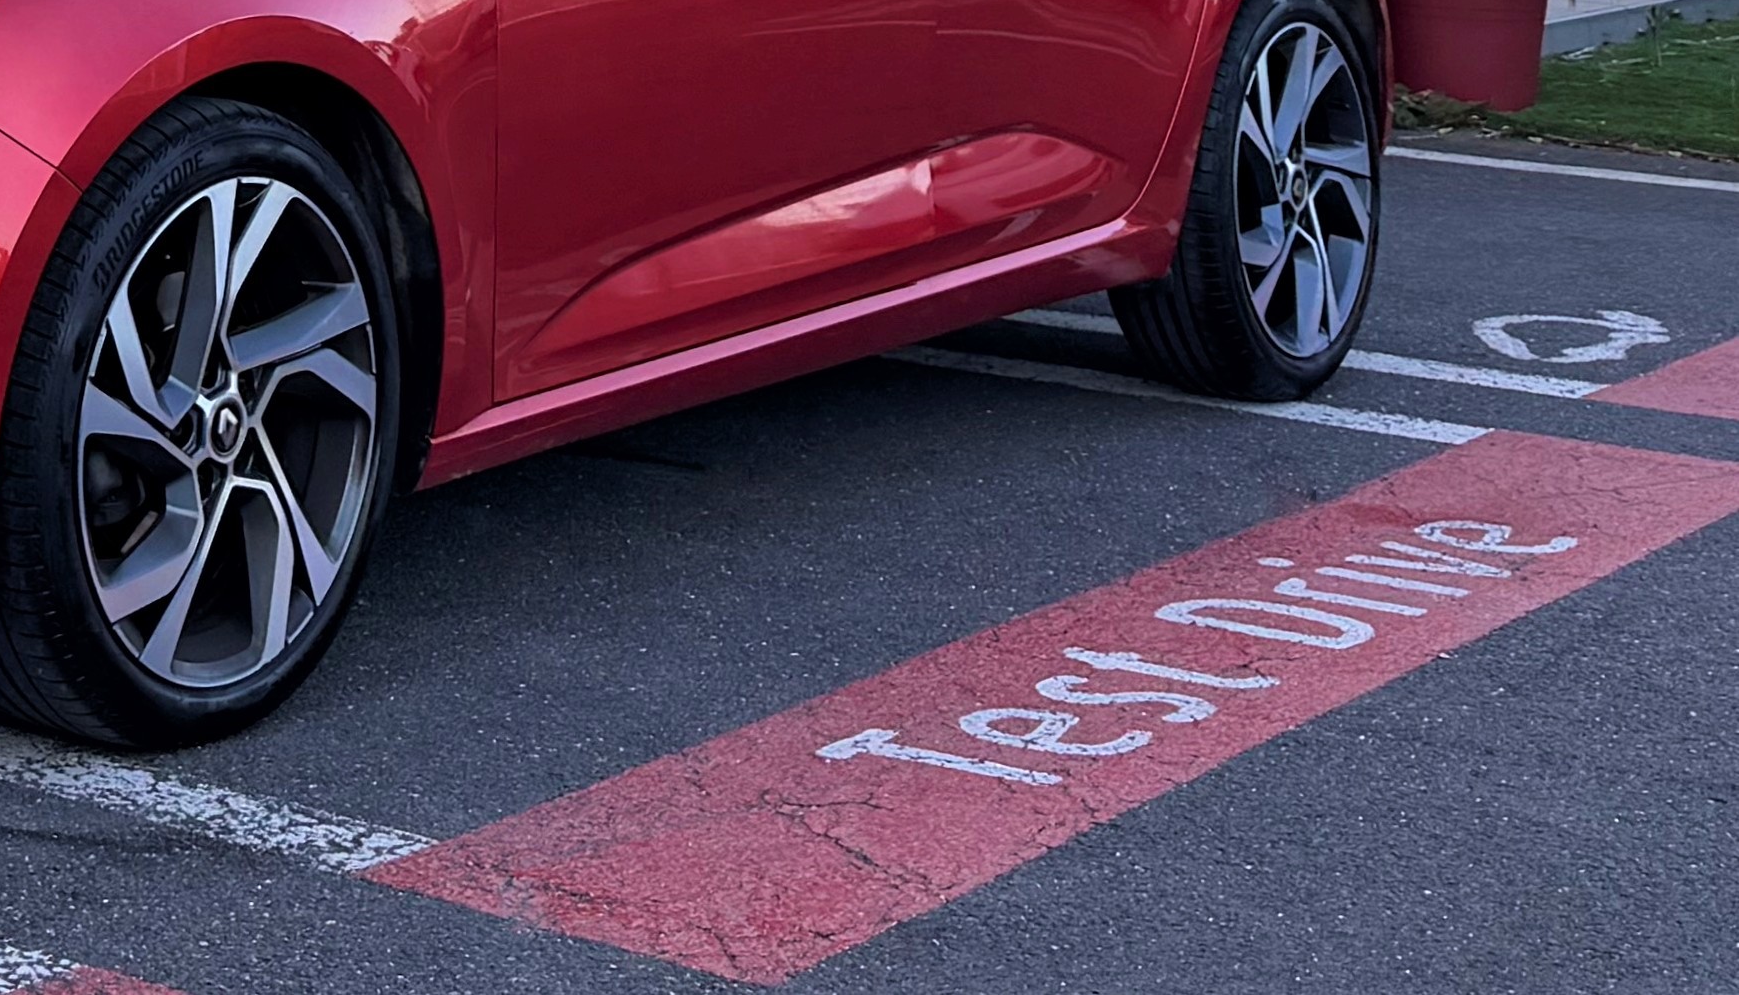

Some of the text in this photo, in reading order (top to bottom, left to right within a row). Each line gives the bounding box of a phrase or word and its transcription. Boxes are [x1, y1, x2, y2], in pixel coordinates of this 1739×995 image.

[92, 149, 205, 296] BRIDGESTONE
[815, 519, 1579, 785] Test Drive
